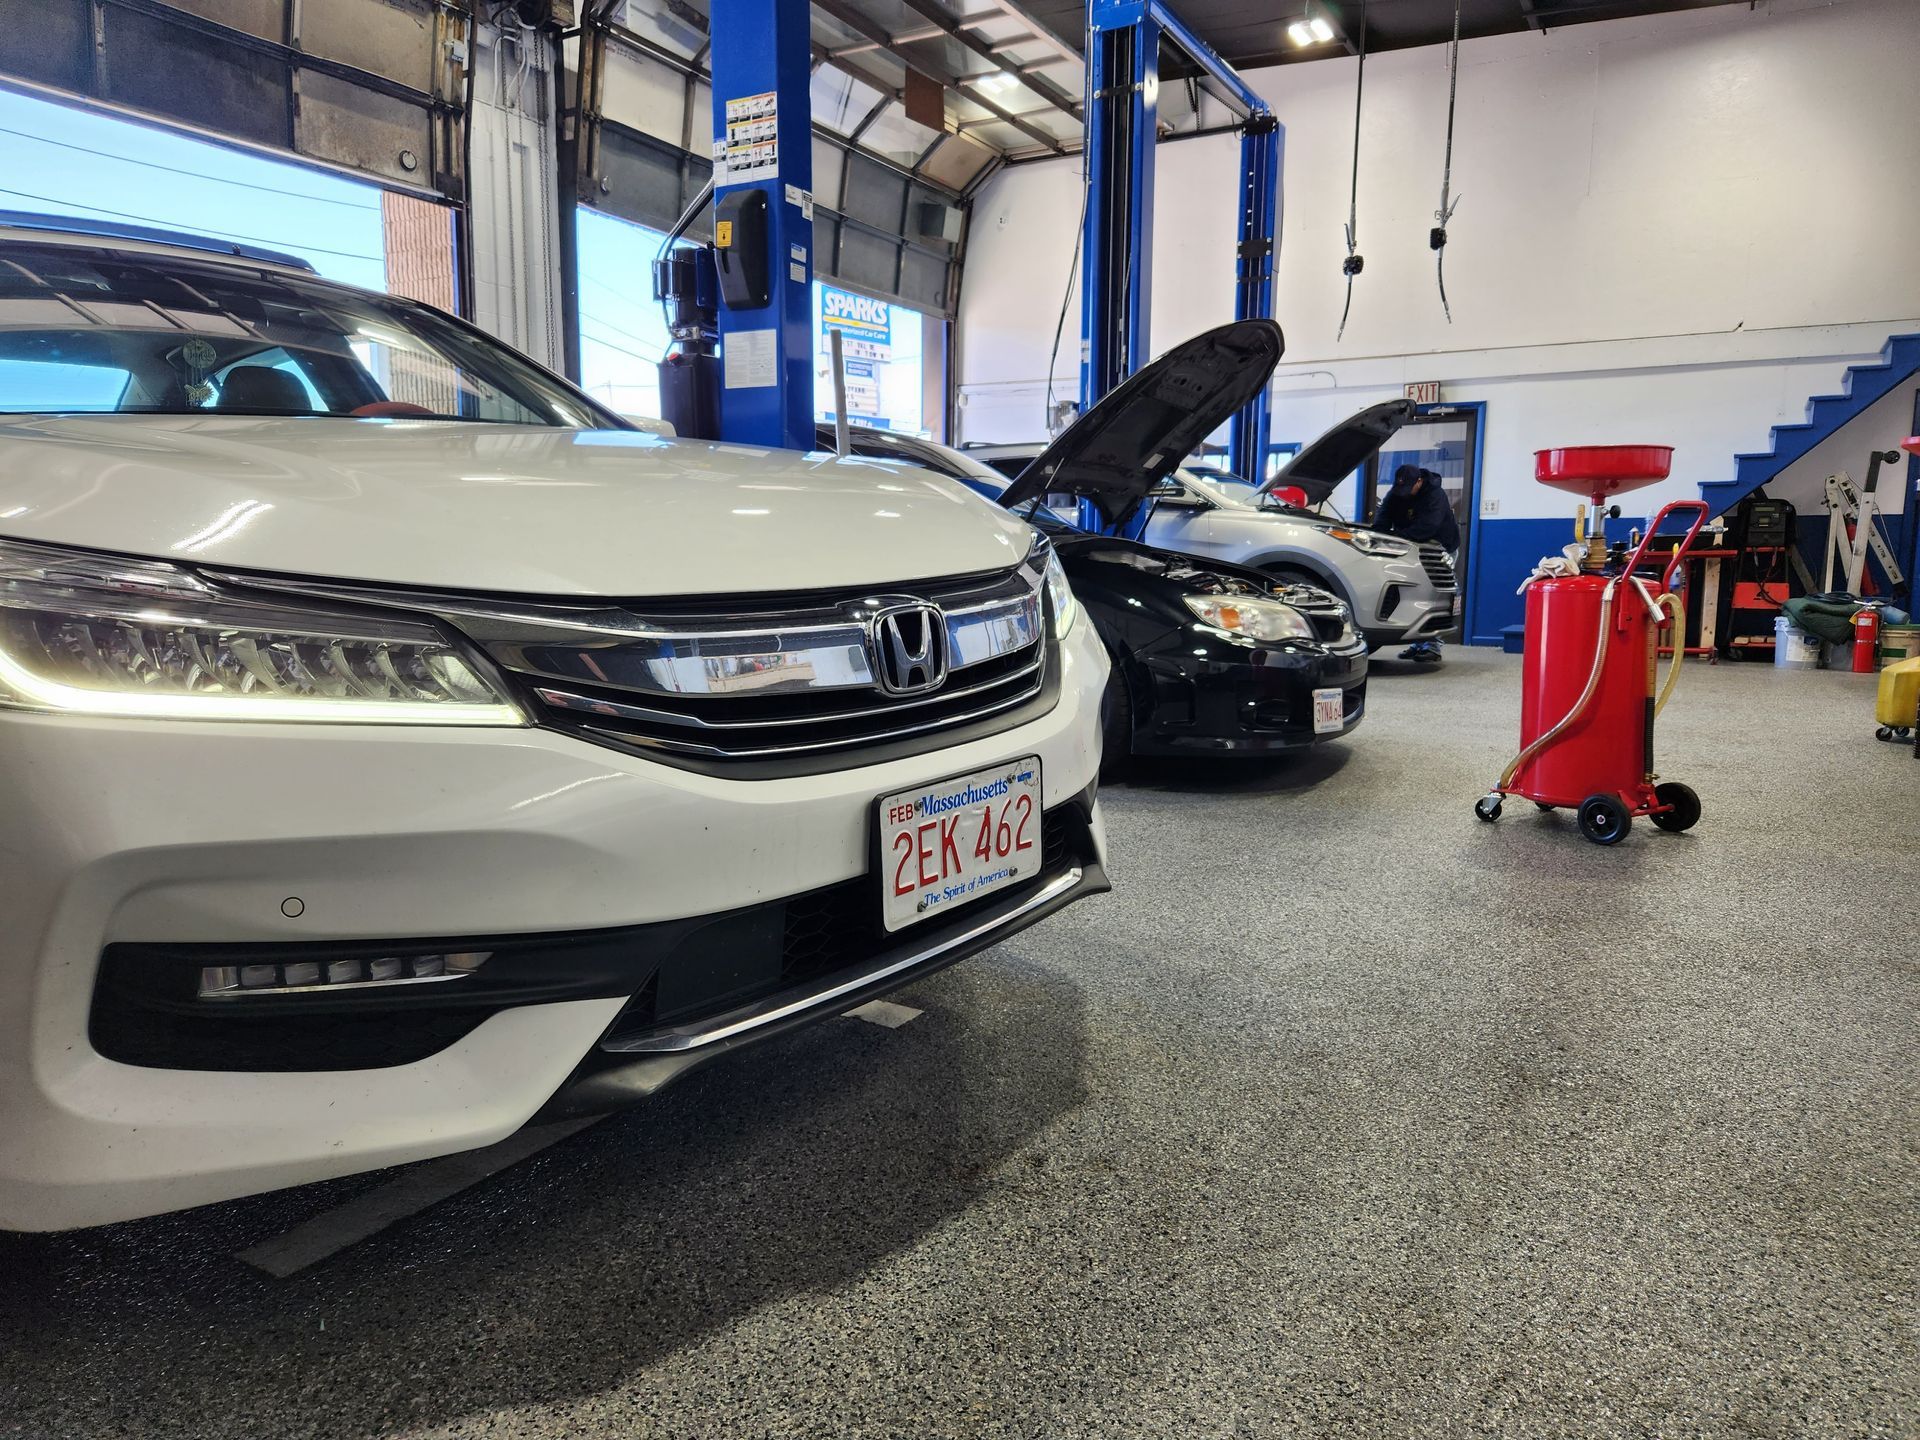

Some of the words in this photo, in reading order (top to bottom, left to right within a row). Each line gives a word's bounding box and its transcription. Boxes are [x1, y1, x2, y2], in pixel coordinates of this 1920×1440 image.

[825, 291, 888, 325] SPARKS
[1407, 384, 1438, 402] EXIT
[889, 803, 914, 825] FEB
[921, 778, 1009, 817] Massachusetts
[893, 813, 962, 897] 2EK
[974, 793, 1033, 863] 462
[924, 893, 941, 907] The
[943, 884, 966, 900] Spirit
[968, 880, 976, 892] of
[977, 868, 1009, 888] America
